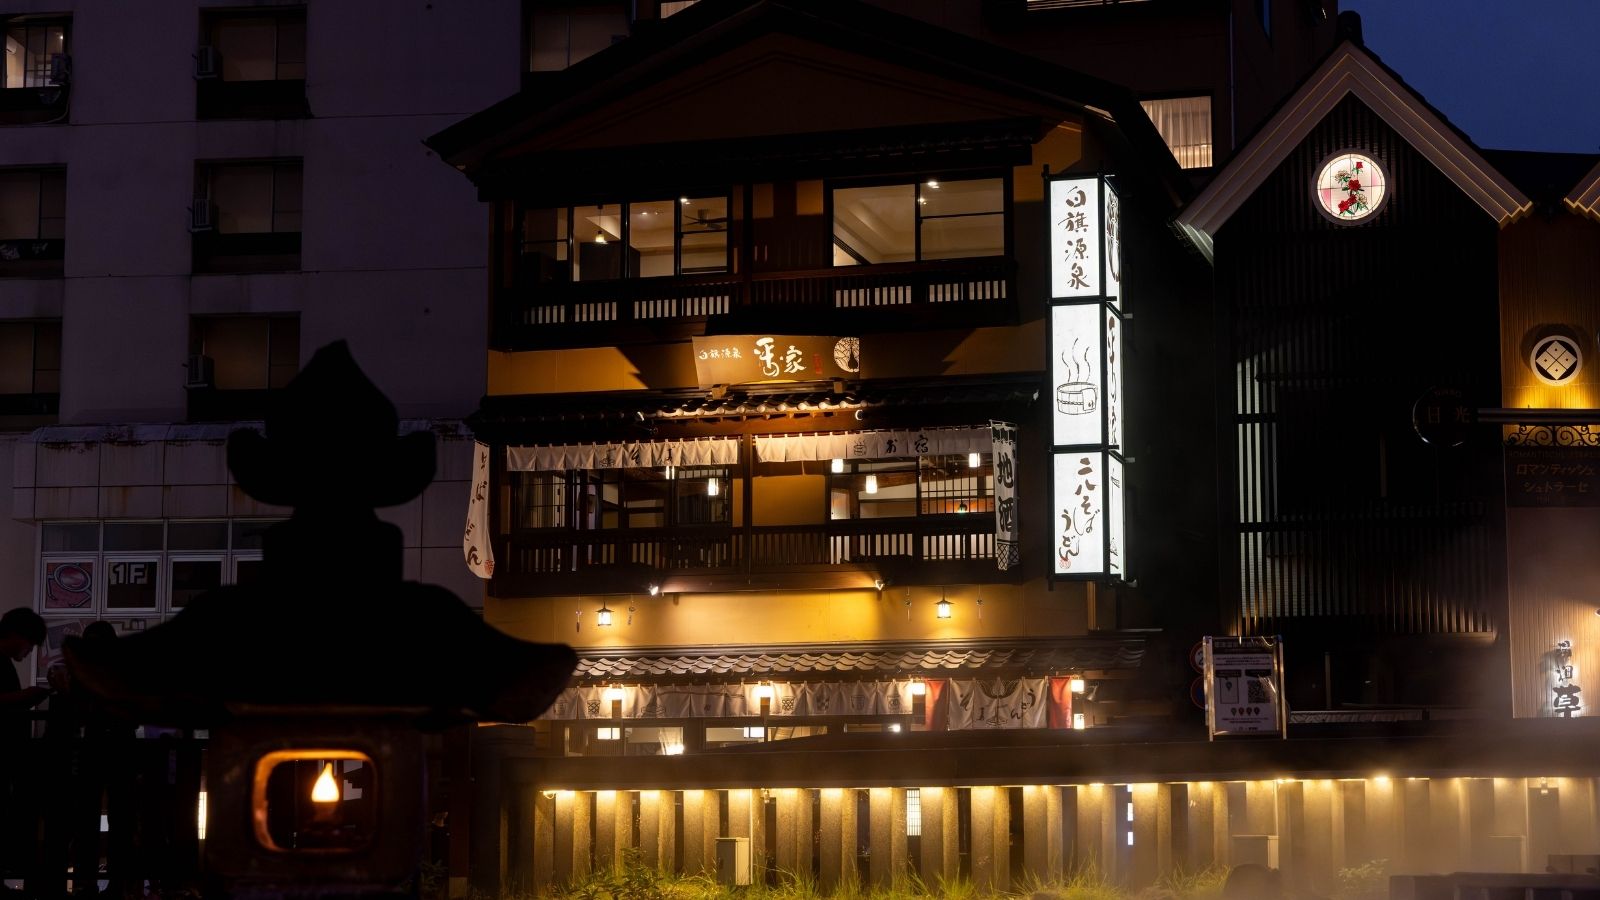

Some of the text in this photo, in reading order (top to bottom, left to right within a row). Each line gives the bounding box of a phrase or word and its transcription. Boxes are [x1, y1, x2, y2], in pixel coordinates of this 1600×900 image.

[1058, 186, 1090, 290] 白旗源泉
[996, 451, 1015, 533] 地酒
[1073, 457, 1101, 536] 二八そば
[112, 563, 148, 585] 1F
[1058, 508, 1080, 561] うどん
